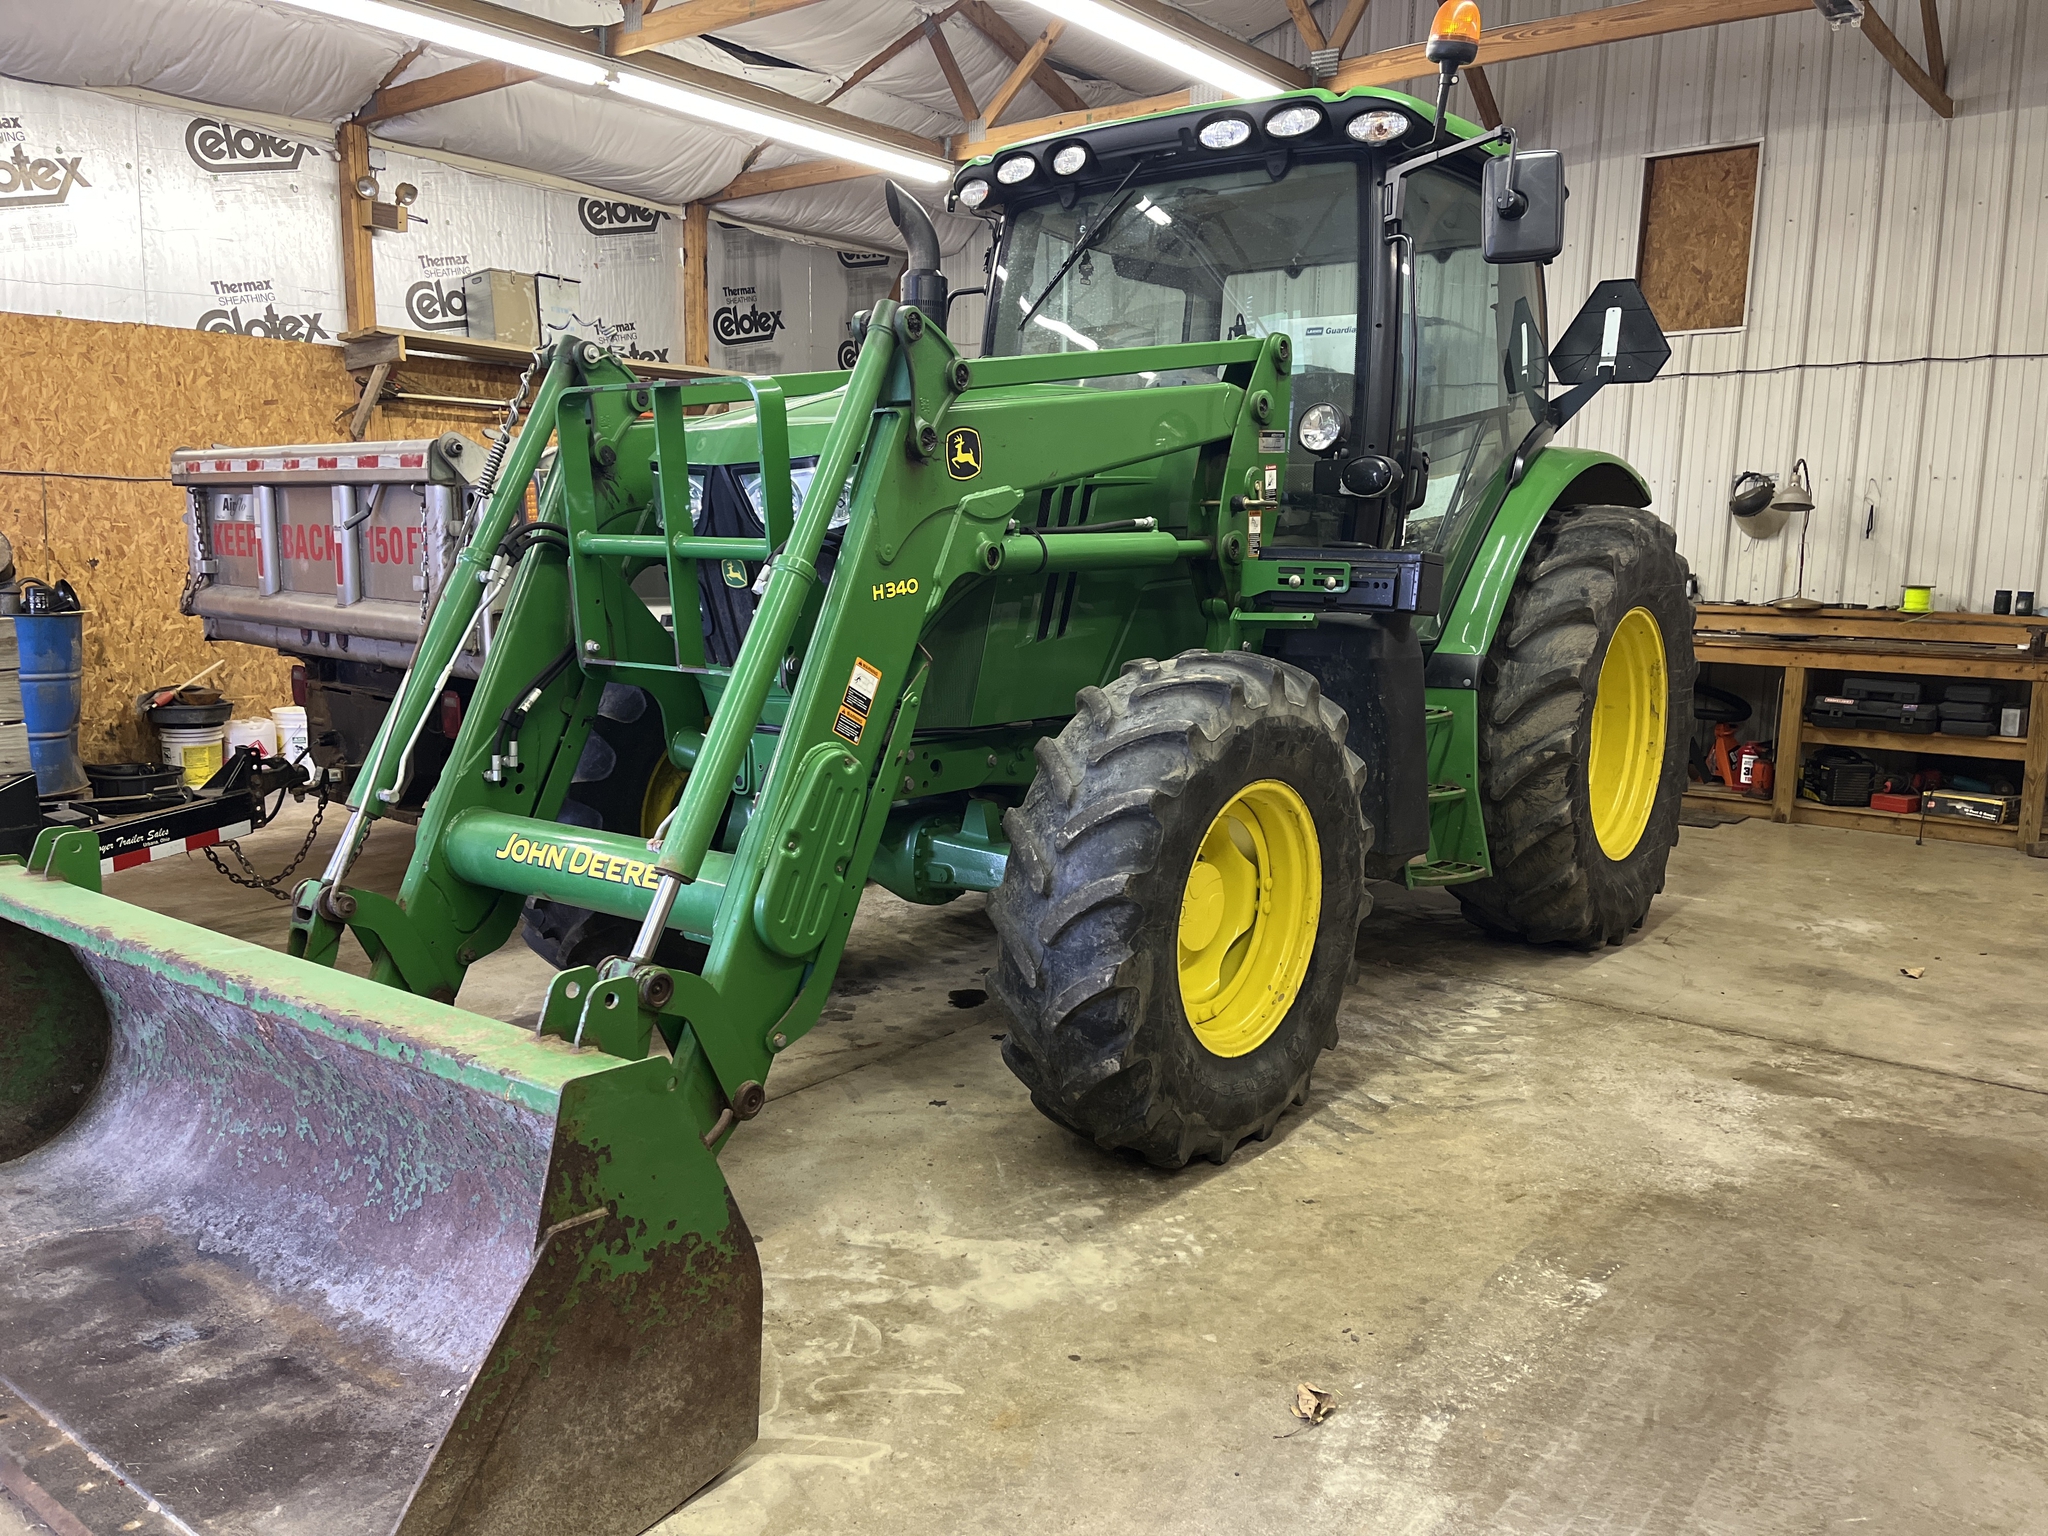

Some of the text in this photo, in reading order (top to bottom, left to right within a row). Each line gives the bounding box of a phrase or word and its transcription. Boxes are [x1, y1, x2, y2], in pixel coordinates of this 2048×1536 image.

[418, 255, 470, 269] Thermax
[423, 266, 472, 279] SHEATHING
[210, 279, 273, 295] Thermax
[722, 286, 756, 297] Thermax
[218, 292, 276, 307] SHEATHING
[725, 295, 758, 305] SHEATHING
[713, 303, 786, 345] Celotex
[872, 577, 919, 601] H340
[116, 834, 144, 848] Trailer
[147, 827, 169, 841] Sales
[496, 832, 660, 891] JOHN DEERE
